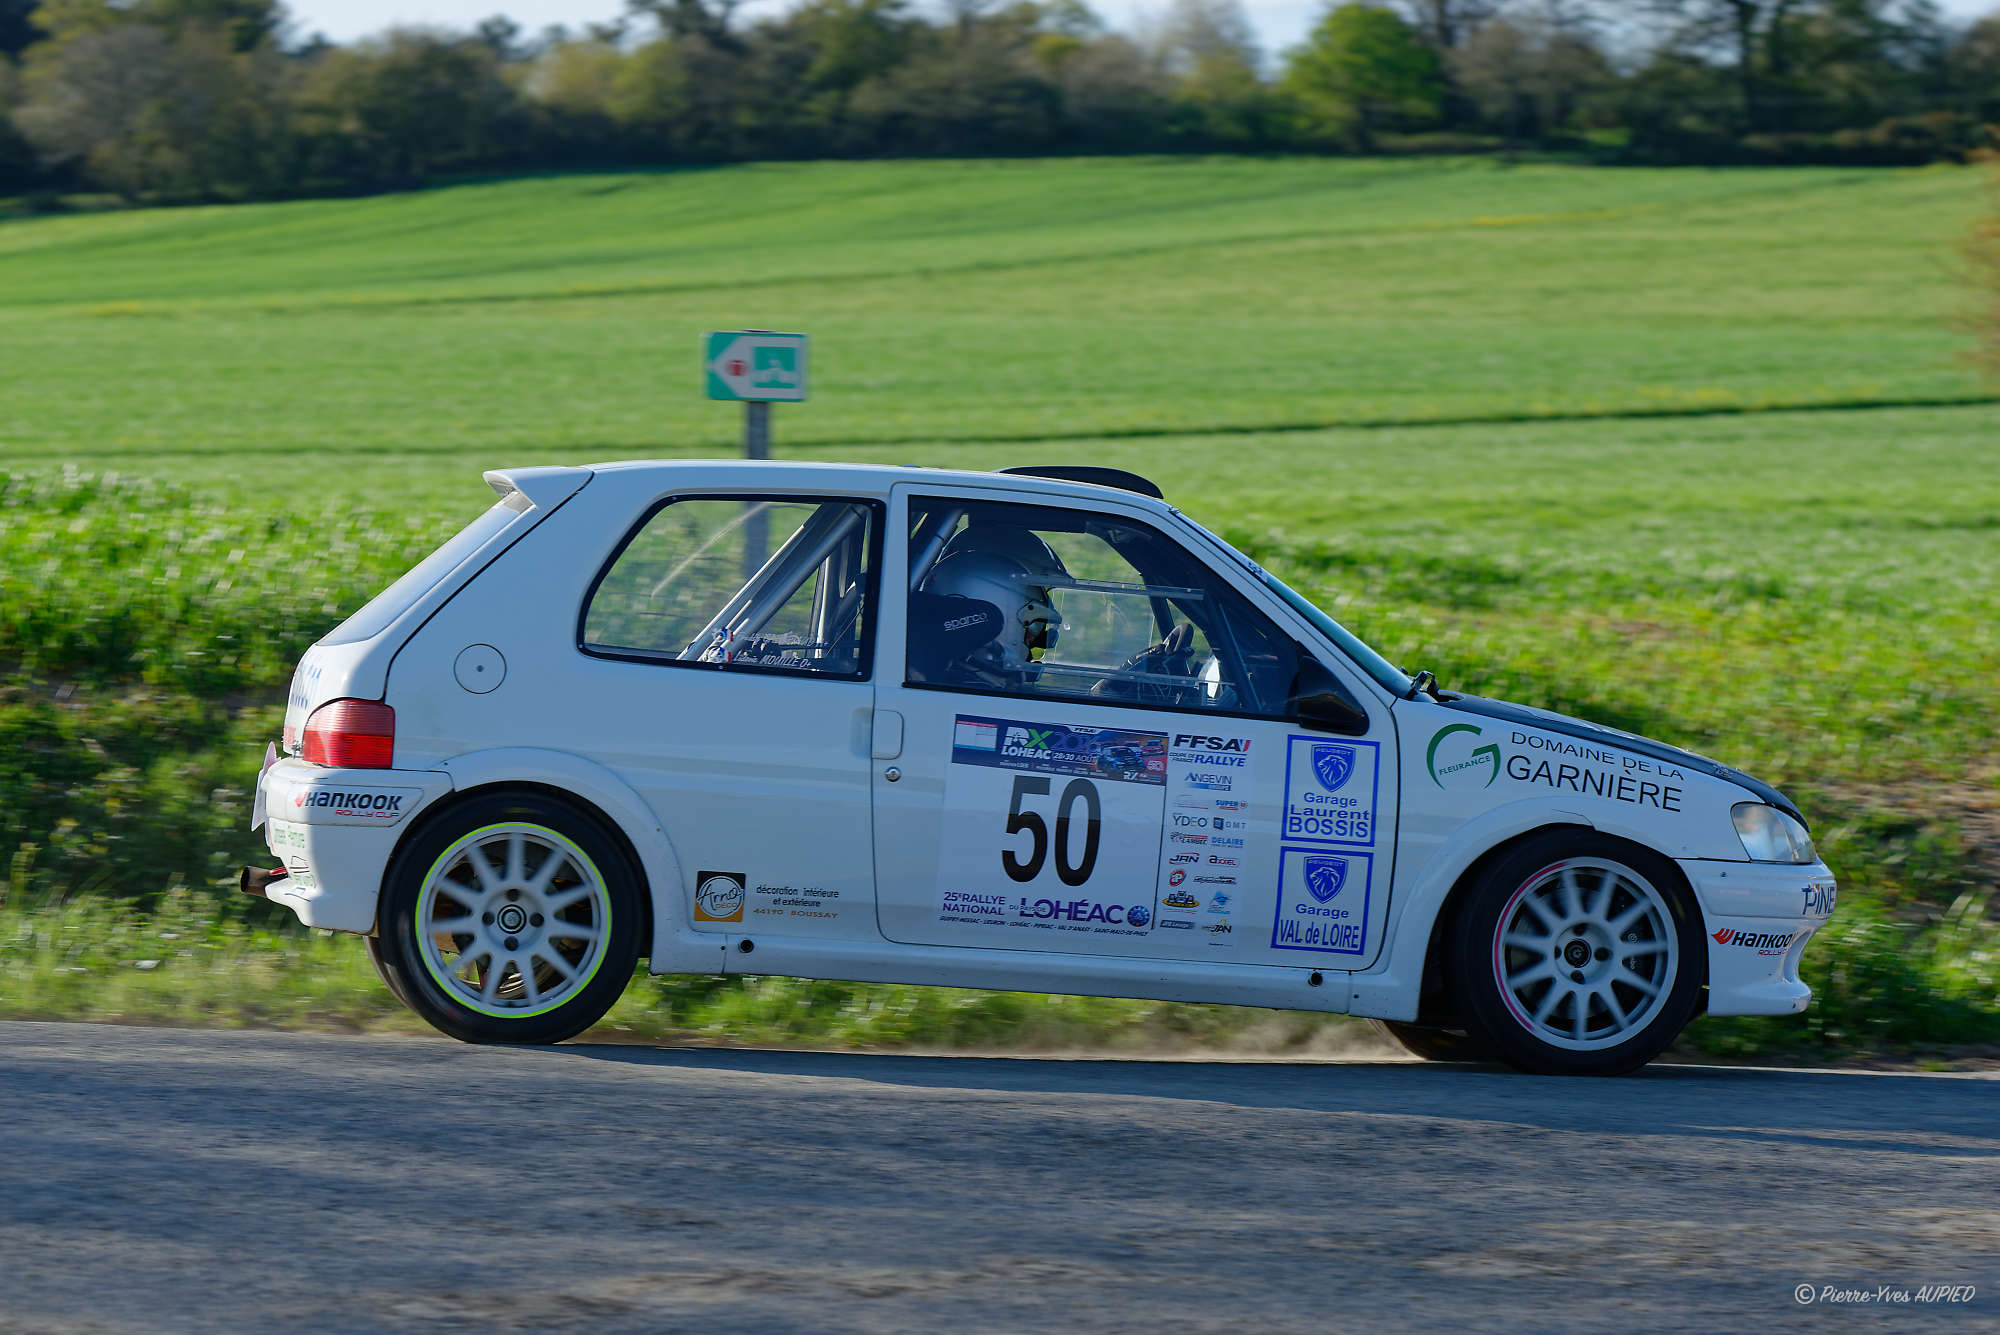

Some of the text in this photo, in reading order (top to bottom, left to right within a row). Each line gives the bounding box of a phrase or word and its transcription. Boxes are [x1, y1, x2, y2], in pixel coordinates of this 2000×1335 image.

[944, 612, 988, 631] sparco
[1173, 734, 1241, 752] FFSA
[1001, 745, 1052, 760] LOHEAC
[1194, 754, 1246, 767] RALLYE
[1511, 731, 1684, 781] DOMAINE DE LA
[1439, 756, 1491, 776] FLEURANCE
[1184, 772, 1232, 785] ANGEVIN
[1506, 755, 1683, 813] GARNIÈRE
[1303, 792, 1357, 807] Garage
[1290, 804, 1369, 821] Laurent
[1001, 775, 1101, 887] 50
[1288, 816, 1369, 838] BOSSIS
[756, 885, 839, 898] décoration intérieure
[962, 893, 1006, 905] RALLYE
[772, 898, 821, 908] et extérieure
[942, 903, 1005, 916] NATIONAL
[1019, 898, 1125, 925] LOHÉAC
[1295, 903, 1349, 920] Garage
[790, 910, 839, 918] BOUSSAY
[1280, 919, 1360, 949] VAL de LOIRE
